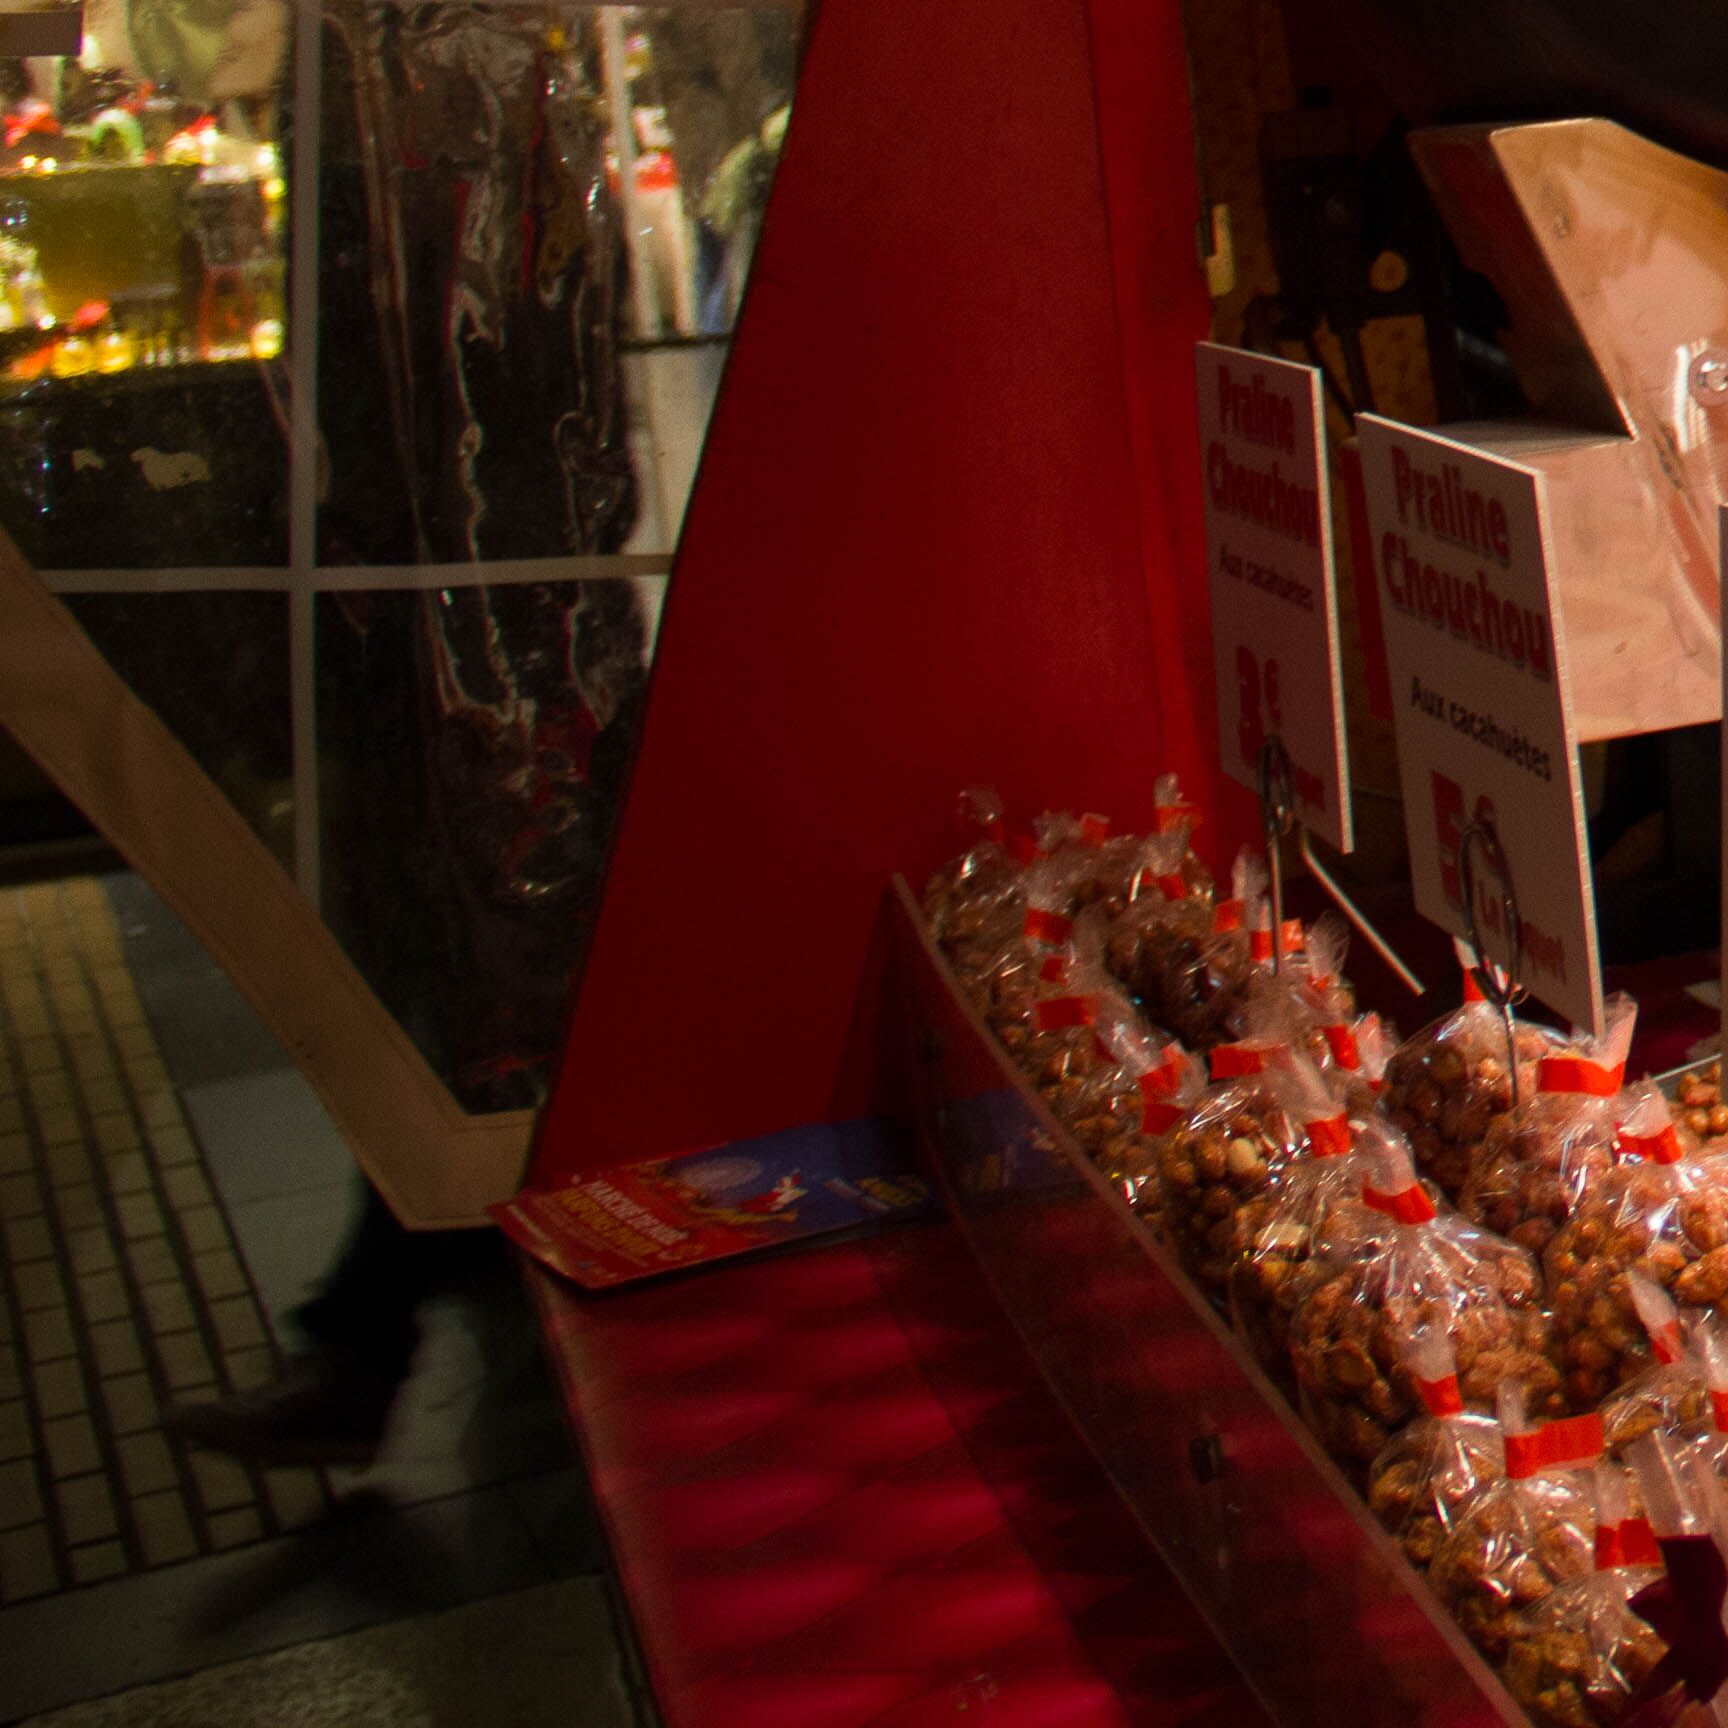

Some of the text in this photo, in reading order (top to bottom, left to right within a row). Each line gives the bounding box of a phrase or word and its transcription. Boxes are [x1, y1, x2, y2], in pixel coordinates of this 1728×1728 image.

[1391, 445, 1511, 567] Praline
[1381, 531, 1551, 682] Chouchou
[1410, 675, 1443, 720] Aux
